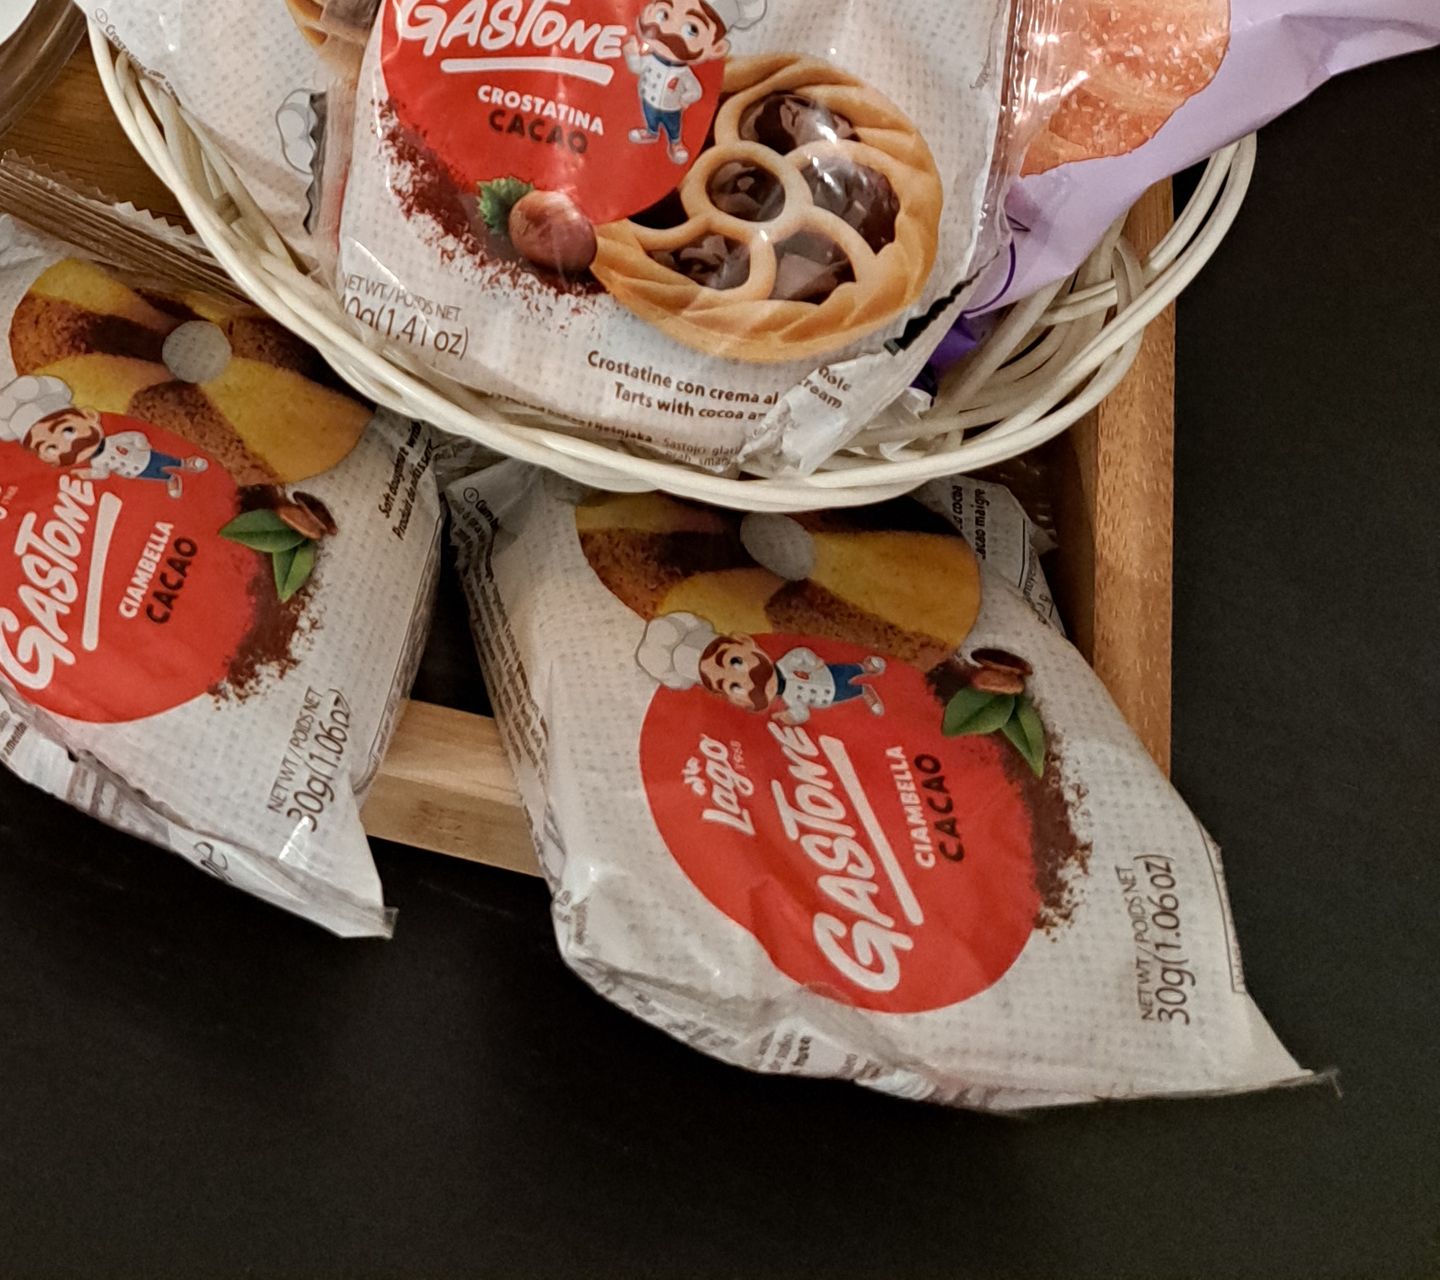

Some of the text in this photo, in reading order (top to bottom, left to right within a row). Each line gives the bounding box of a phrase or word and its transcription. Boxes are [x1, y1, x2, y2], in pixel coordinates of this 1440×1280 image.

[477, 84, 605, 137] CROSTATINA
[488, 108, 589, 155] CACAO
[365, 280, 388, 300] WT
[436, 303, 463, 322] NET
[587, 350, 780, 406] Crostatine con crema al
[613, 380, 653, 409] Tarts
[656, 397, 695, 418] with
[698, 406, 745, 421] cocoa
[377, 490, 395, 520] Soft
[118, 520, 175, 619] CIAMBELLA
[145, 536, 199, 625] CACAO
[266, 685, 324, 814] NET WT POIDS NET
[700, 733, 757, 836] Lago
[885, 745, 936, 869] CIAMBELLA
[913, 752, 965, 864] CACAO
[767, 721, 915, 992] GASTONE
[1132, 853, 1177, 890] oz)
[1114, 865, 1156, 1021] NET WT POIDS NET
